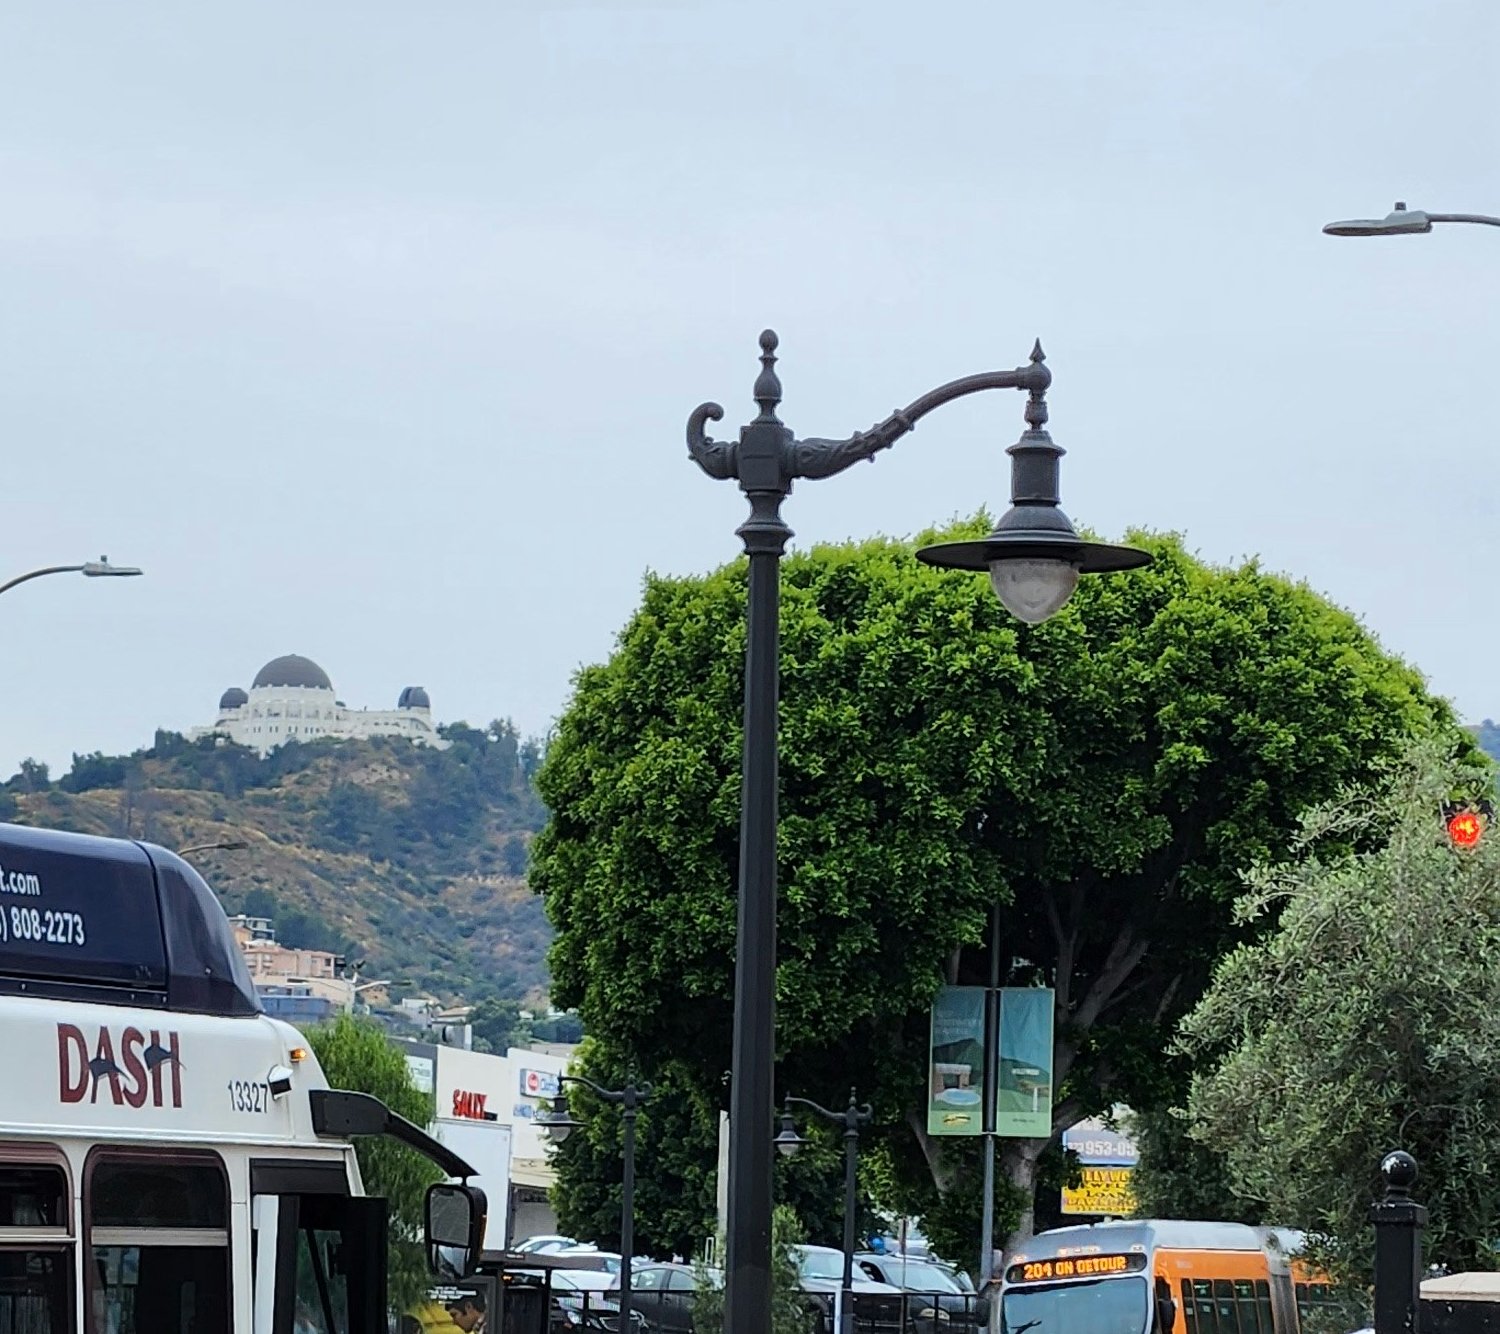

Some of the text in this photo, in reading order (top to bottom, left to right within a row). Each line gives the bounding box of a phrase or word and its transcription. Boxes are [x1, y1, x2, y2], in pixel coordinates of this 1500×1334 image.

[10, 906, 86, 946] 808-2273
[57, 1022, 187, 1109] DASH
[228, 1080, 268, 1114] 13327
[452, 1088, 488, 1120] SALLY
[1024, 1255, 1127, 1280] 204 ON DETOUR
